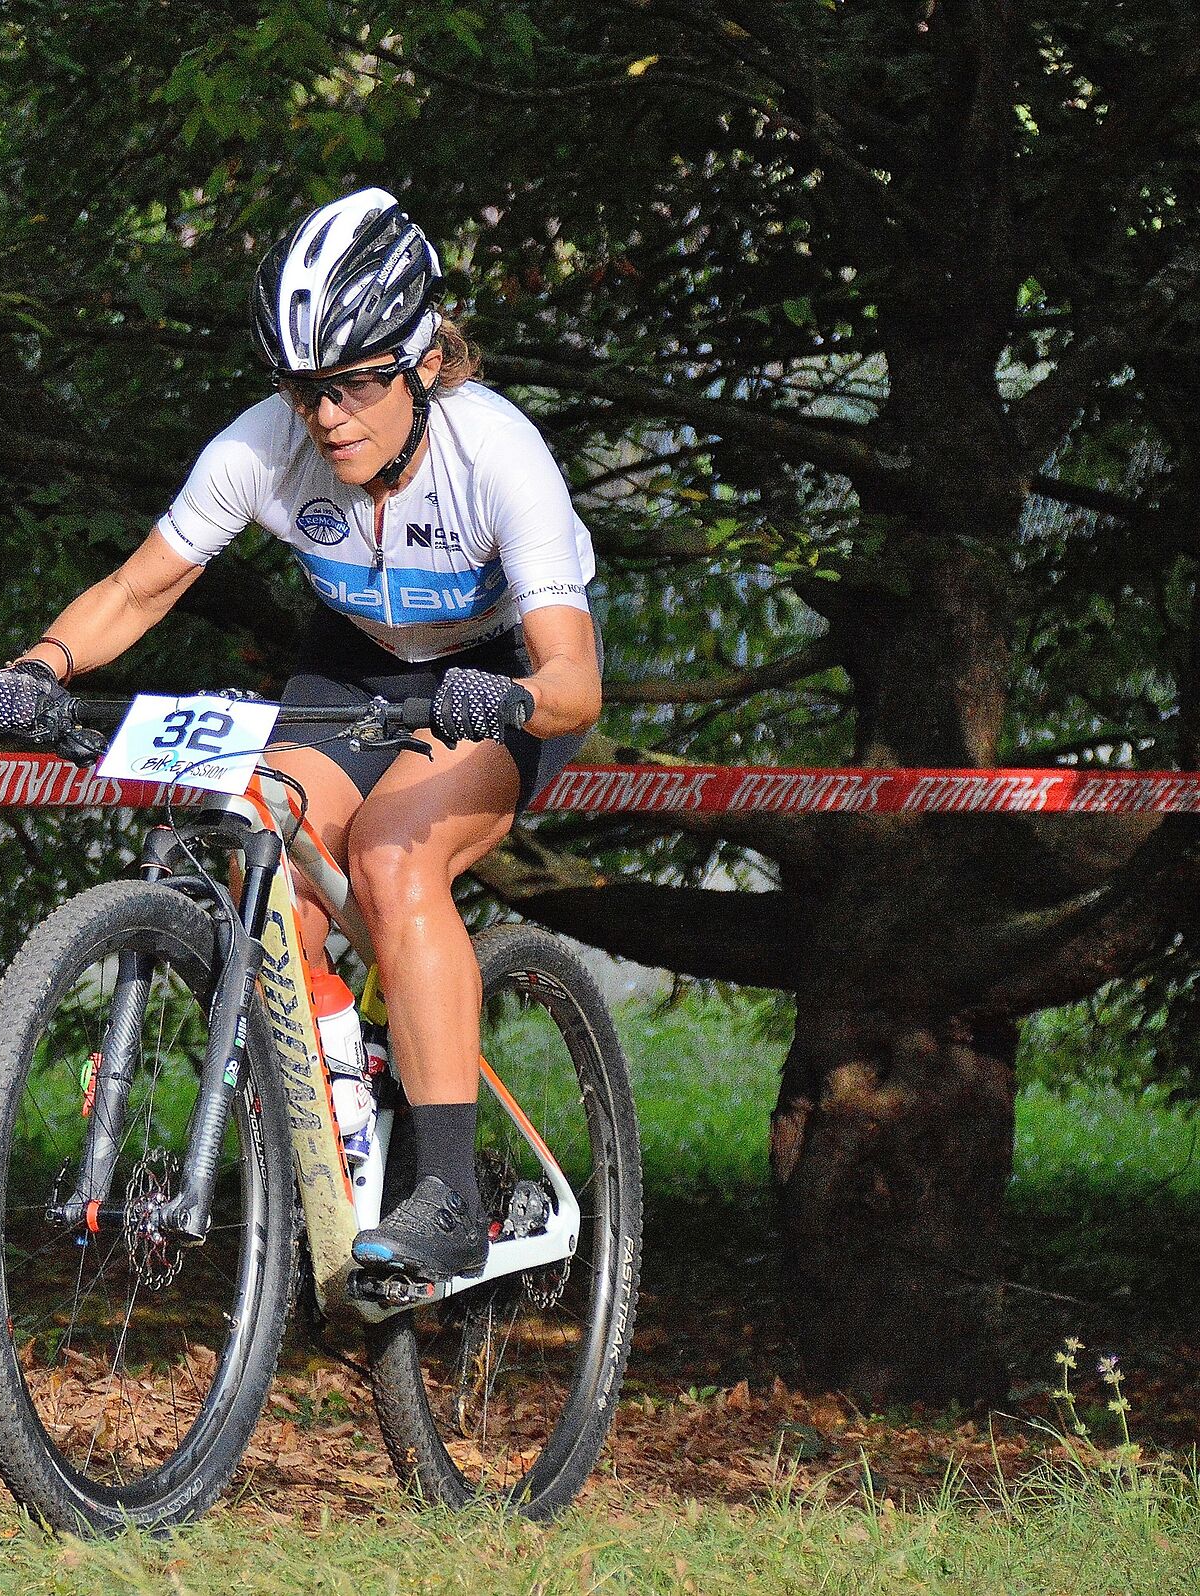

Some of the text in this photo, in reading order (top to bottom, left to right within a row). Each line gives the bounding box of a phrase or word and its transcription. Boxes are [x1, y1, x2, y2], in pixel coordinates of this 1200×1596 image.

[152, 709, 235, 754] 32
[546, 770, 716, 811] SPECIALIZED
[726, 774, 893, 812] SPECIALIZED
[249, 1108, 268, 1191] CONTROL
[621, 1235, 634, 1299] FAST
[609, 1302, 629, 1365] TRAK
